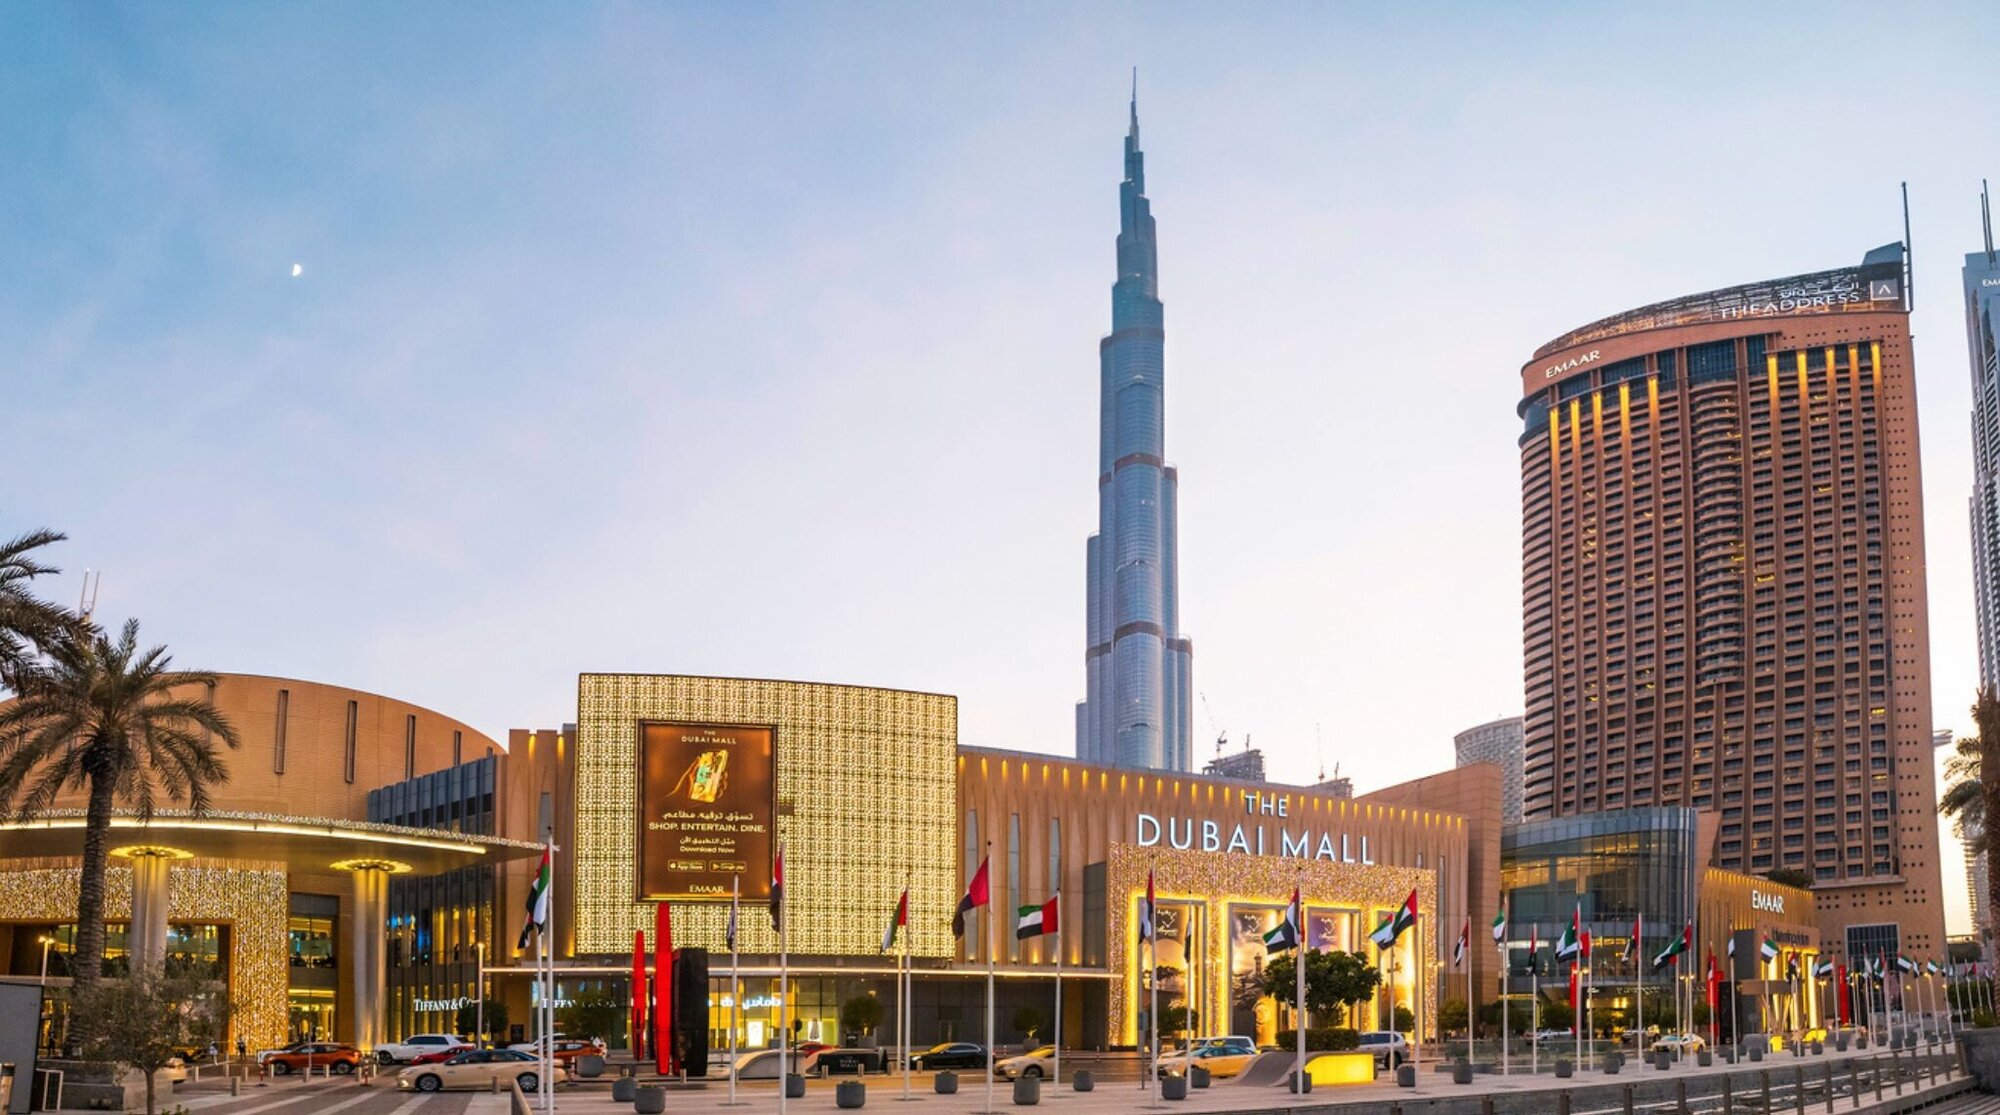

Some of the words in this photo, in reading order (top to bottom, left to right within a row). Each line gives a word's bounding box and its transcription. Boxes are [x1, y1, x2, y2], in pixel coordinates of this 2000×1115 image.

[1545, 349, 1601, 378] EMAAR
[681, 735, 710, 743] DUBAI
[711, 737, 737, 745] MALL
[1244, 794, 1289, 817] THE
[648, 821, 679, 831] SHOP.
[681, 822, 739, 833] ENTERTAIN.
[740, 824, 767, 833] DINE.
[1137, 813, 1264, 857] DUBAI
[1281, 827, 1375, 866] MALL
[679, 845, 717, 854] Download
[689, 883, 725, 894] EMAAR
[1752, 889, 1785, 914] EMAAR
